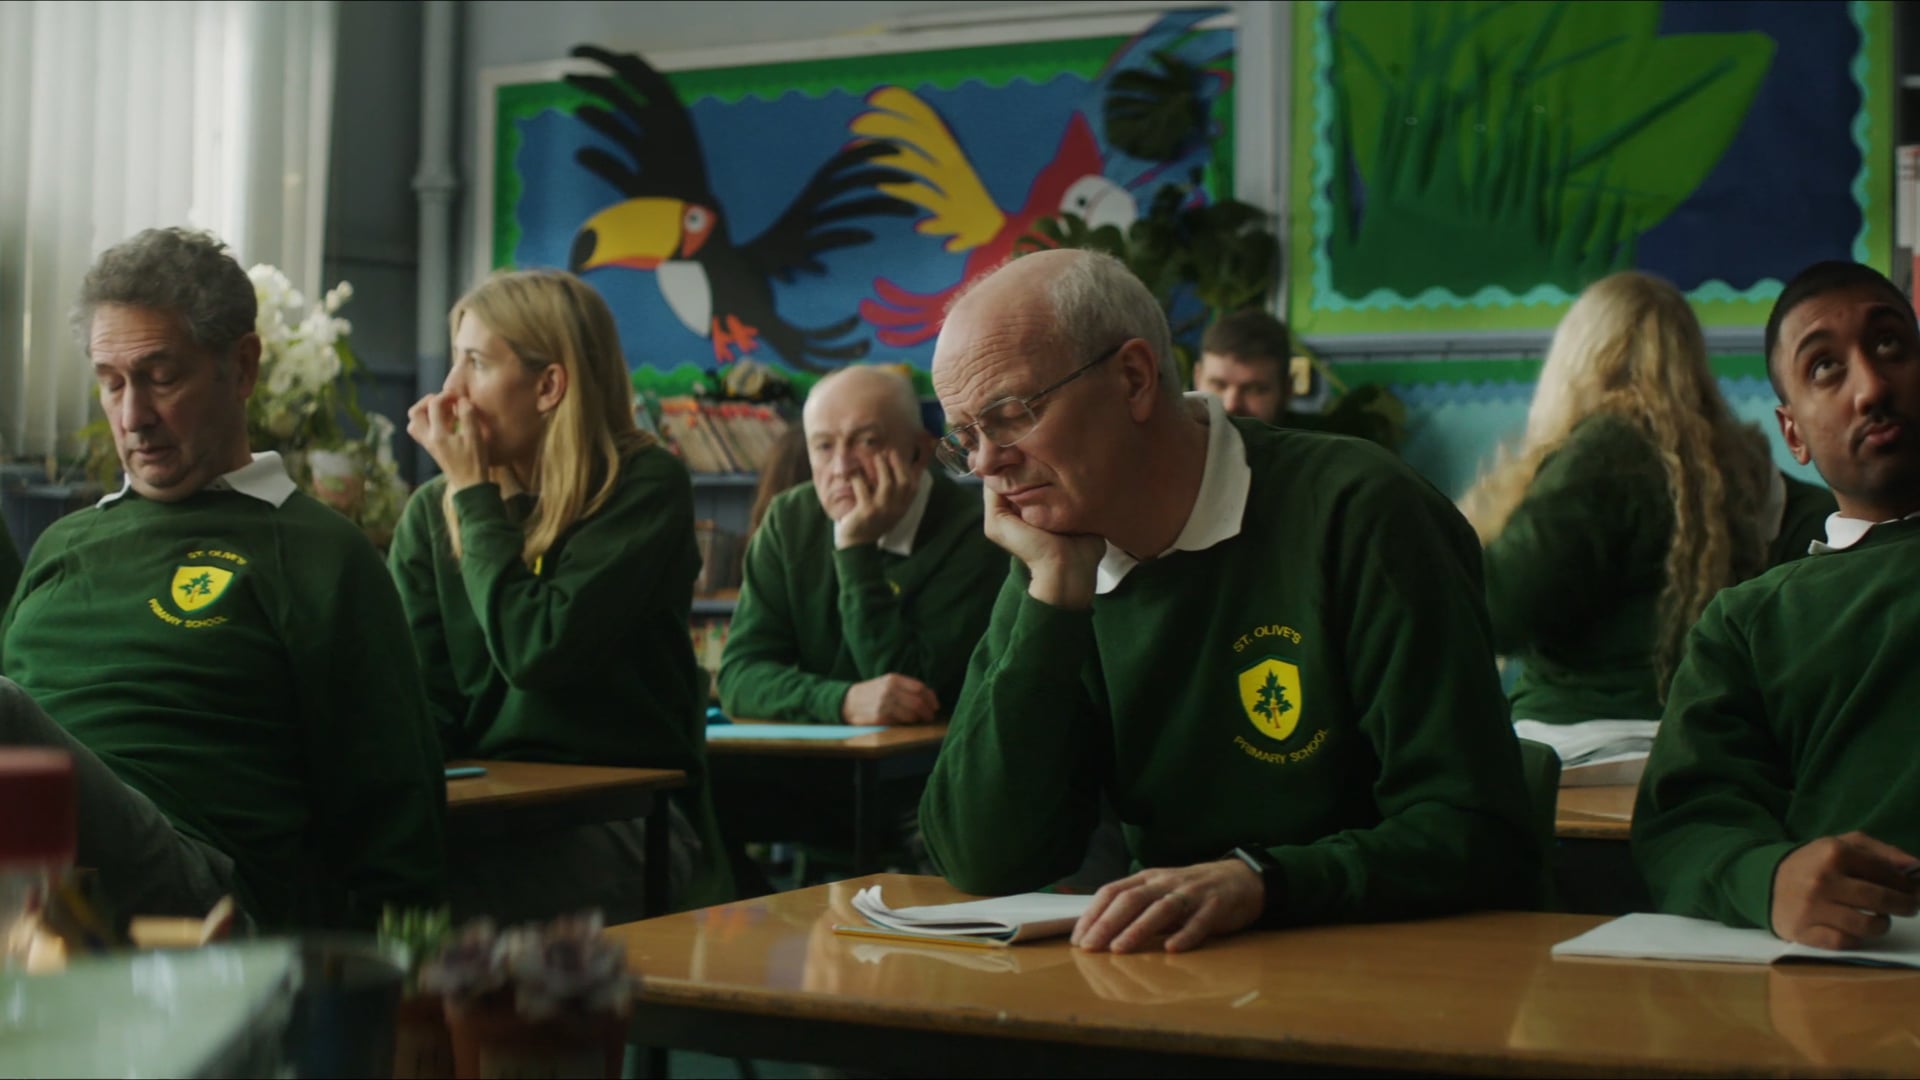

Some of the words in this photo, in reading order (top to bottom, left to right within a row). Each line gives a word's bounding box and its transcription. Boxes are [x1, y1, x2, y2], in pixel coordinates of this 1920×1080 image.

[148, 598, 183, 625] PRIMARY
[184, 615, 229, 628] SCHOOL
[1232, 633, 1253, 652] ST.
[1254, 624, 1302, 645] OLIVE'S
[1233, 735, 1287, 764] PRIMARY
[1289, 728, 1329, 762] SCHOOL
